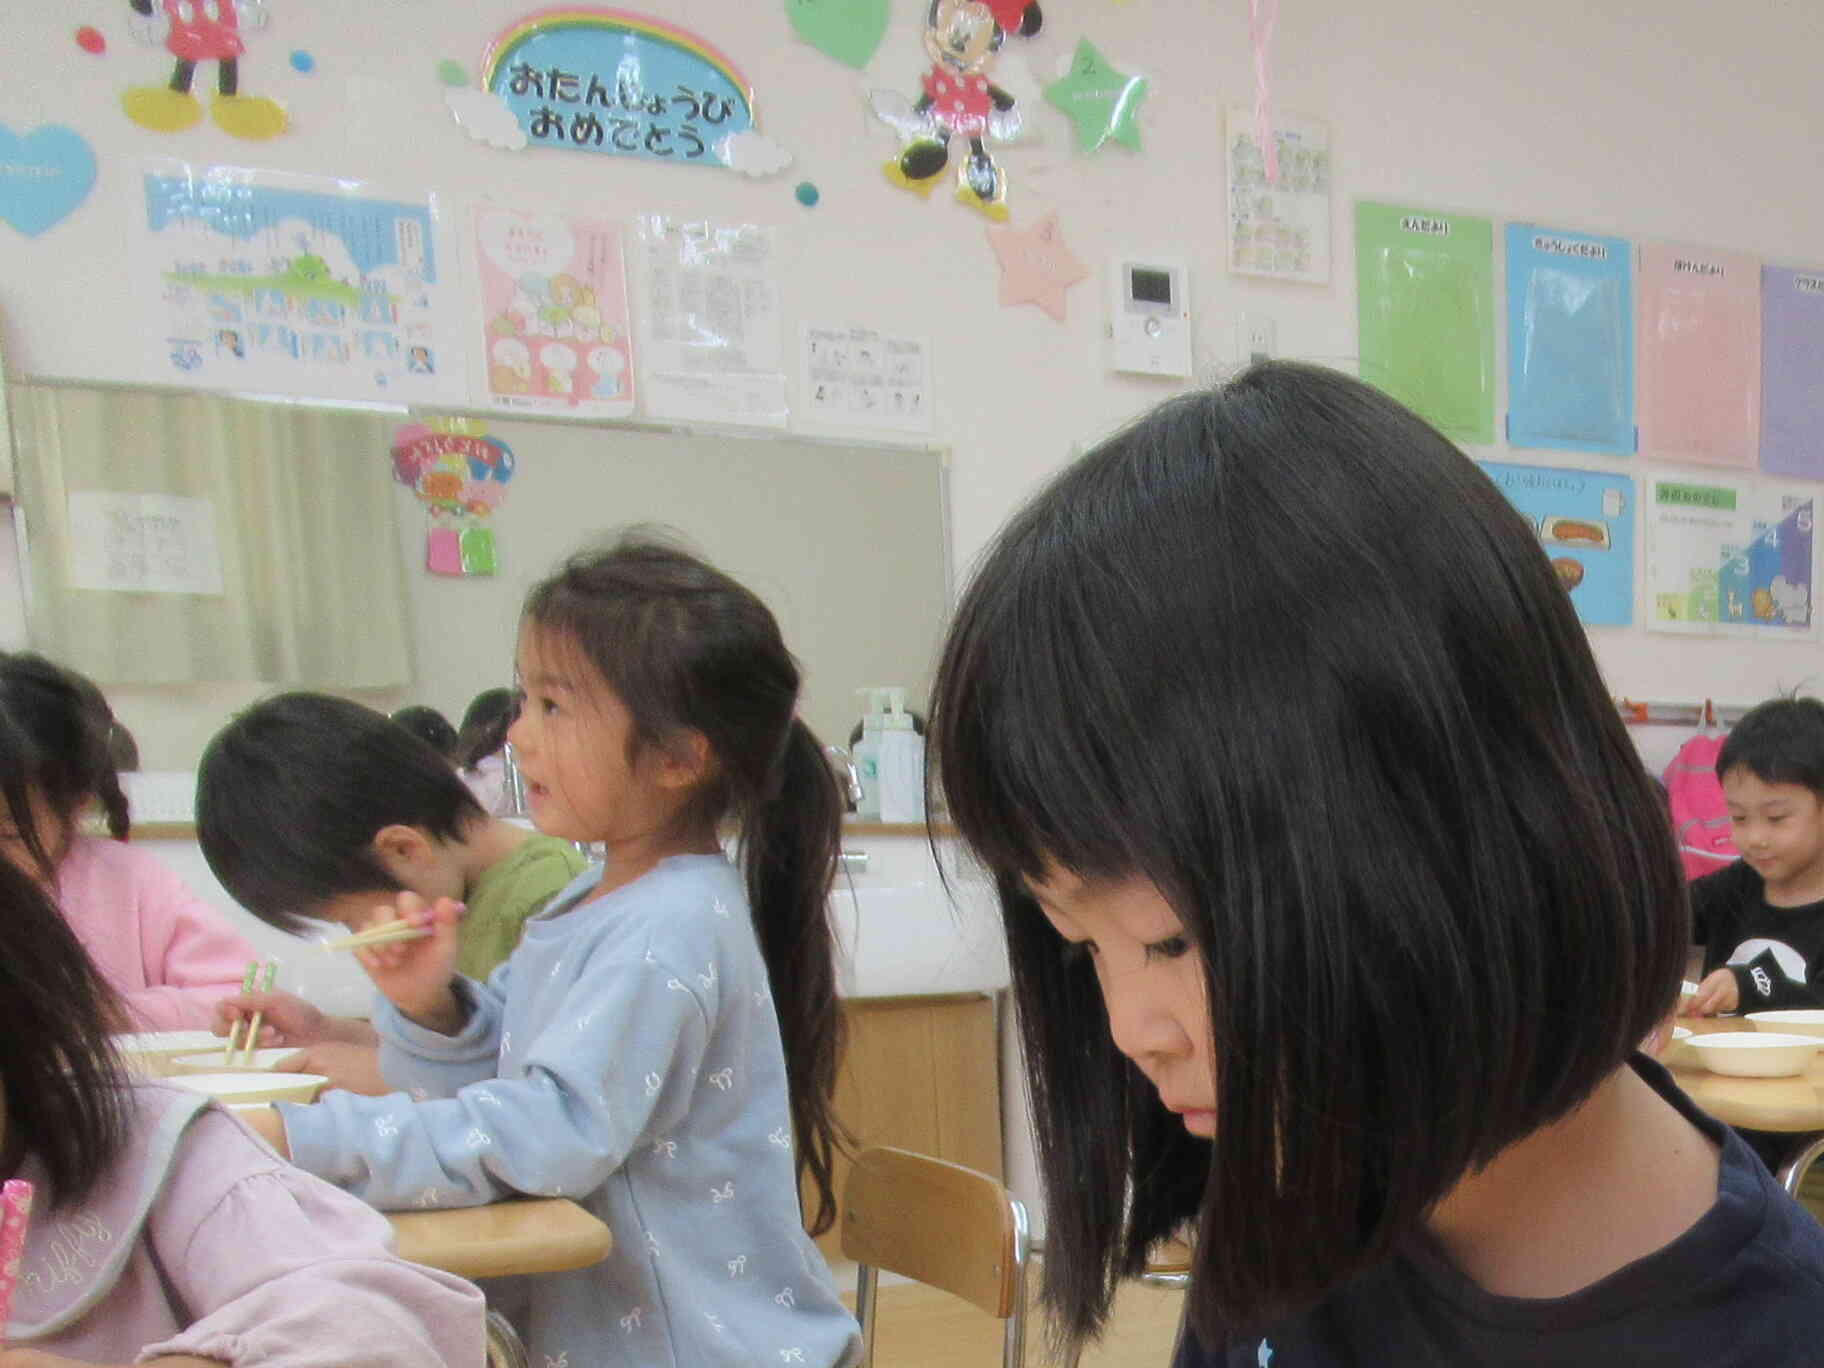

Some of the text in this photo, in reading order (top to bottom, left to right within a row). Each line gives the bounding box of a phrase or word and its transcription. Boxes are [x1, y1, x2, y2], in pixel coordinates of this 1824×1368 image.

[528, 104, 705, 159] おめでとう
